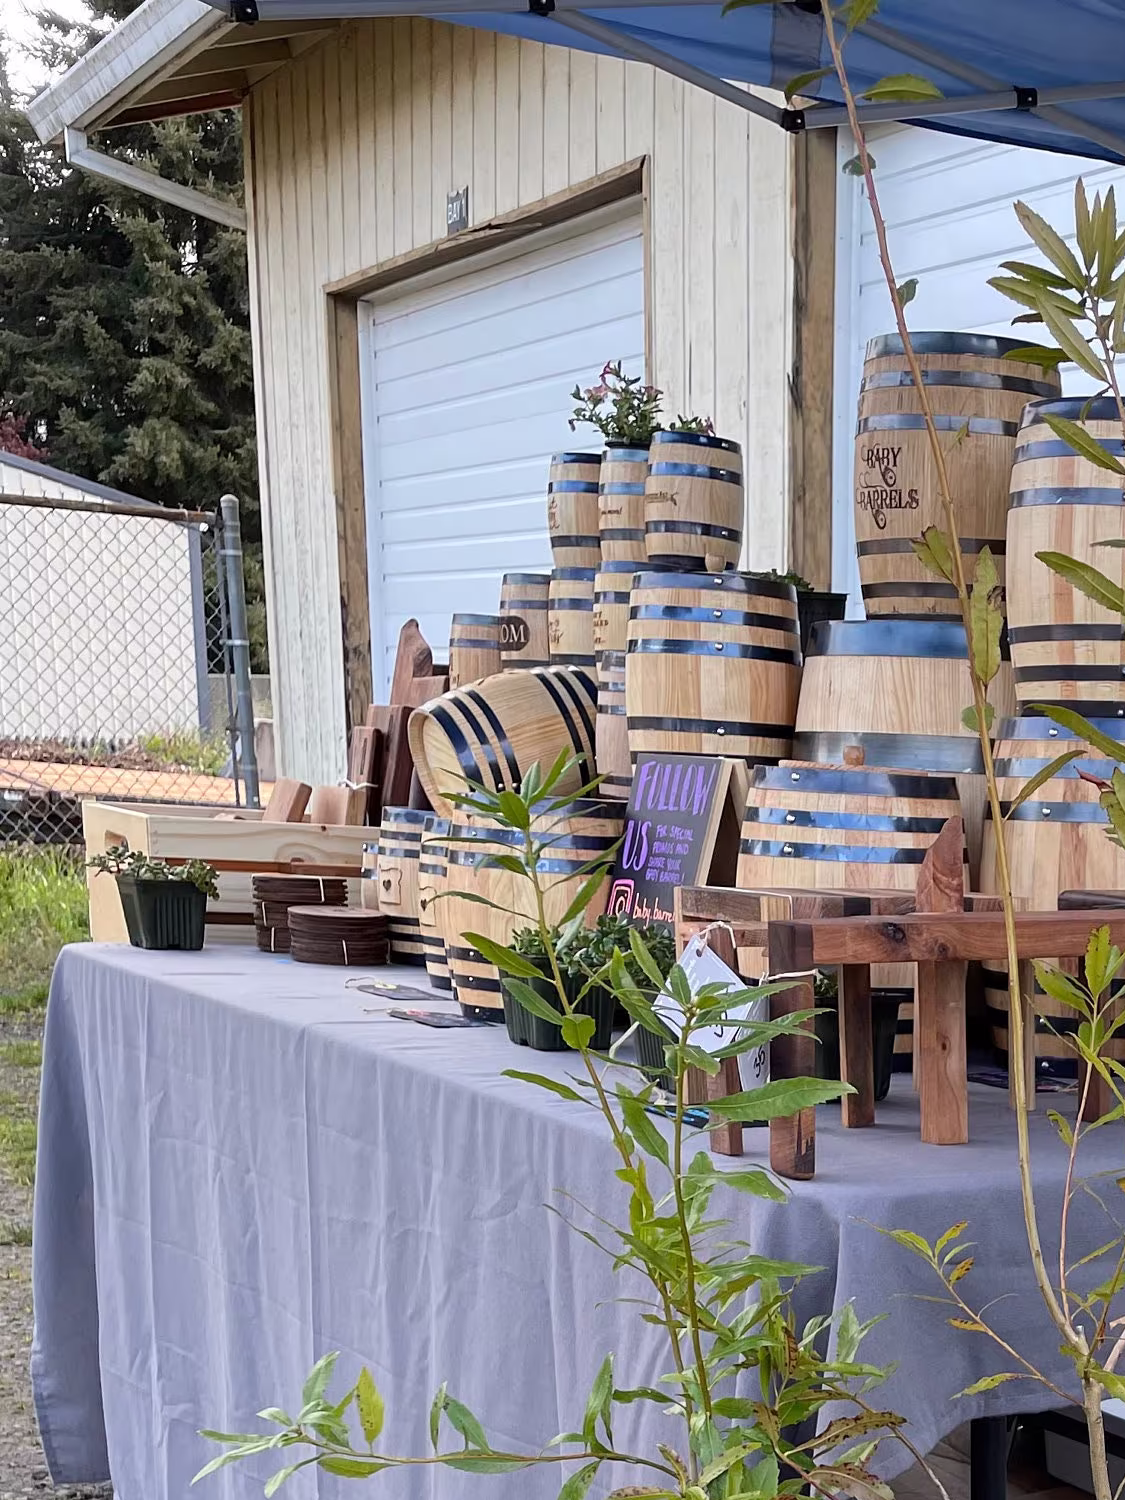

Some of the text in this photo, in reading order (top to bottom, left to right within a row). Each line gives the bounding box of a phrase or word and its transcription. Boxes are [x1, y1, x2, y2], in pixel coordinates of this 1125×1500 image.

[447, 200, 461, 224] BAY
[862, 443, 902, 470] BABY
[857, 487, 919, 518] BARRELS
[500, 624, 527, 643] OM
[634, 761, 716, 816] FOLLOW
[622, 820, 652, 871] US
[670, 825, 694, 841] SPECIAL
[675, 843, 689, 855] AND
